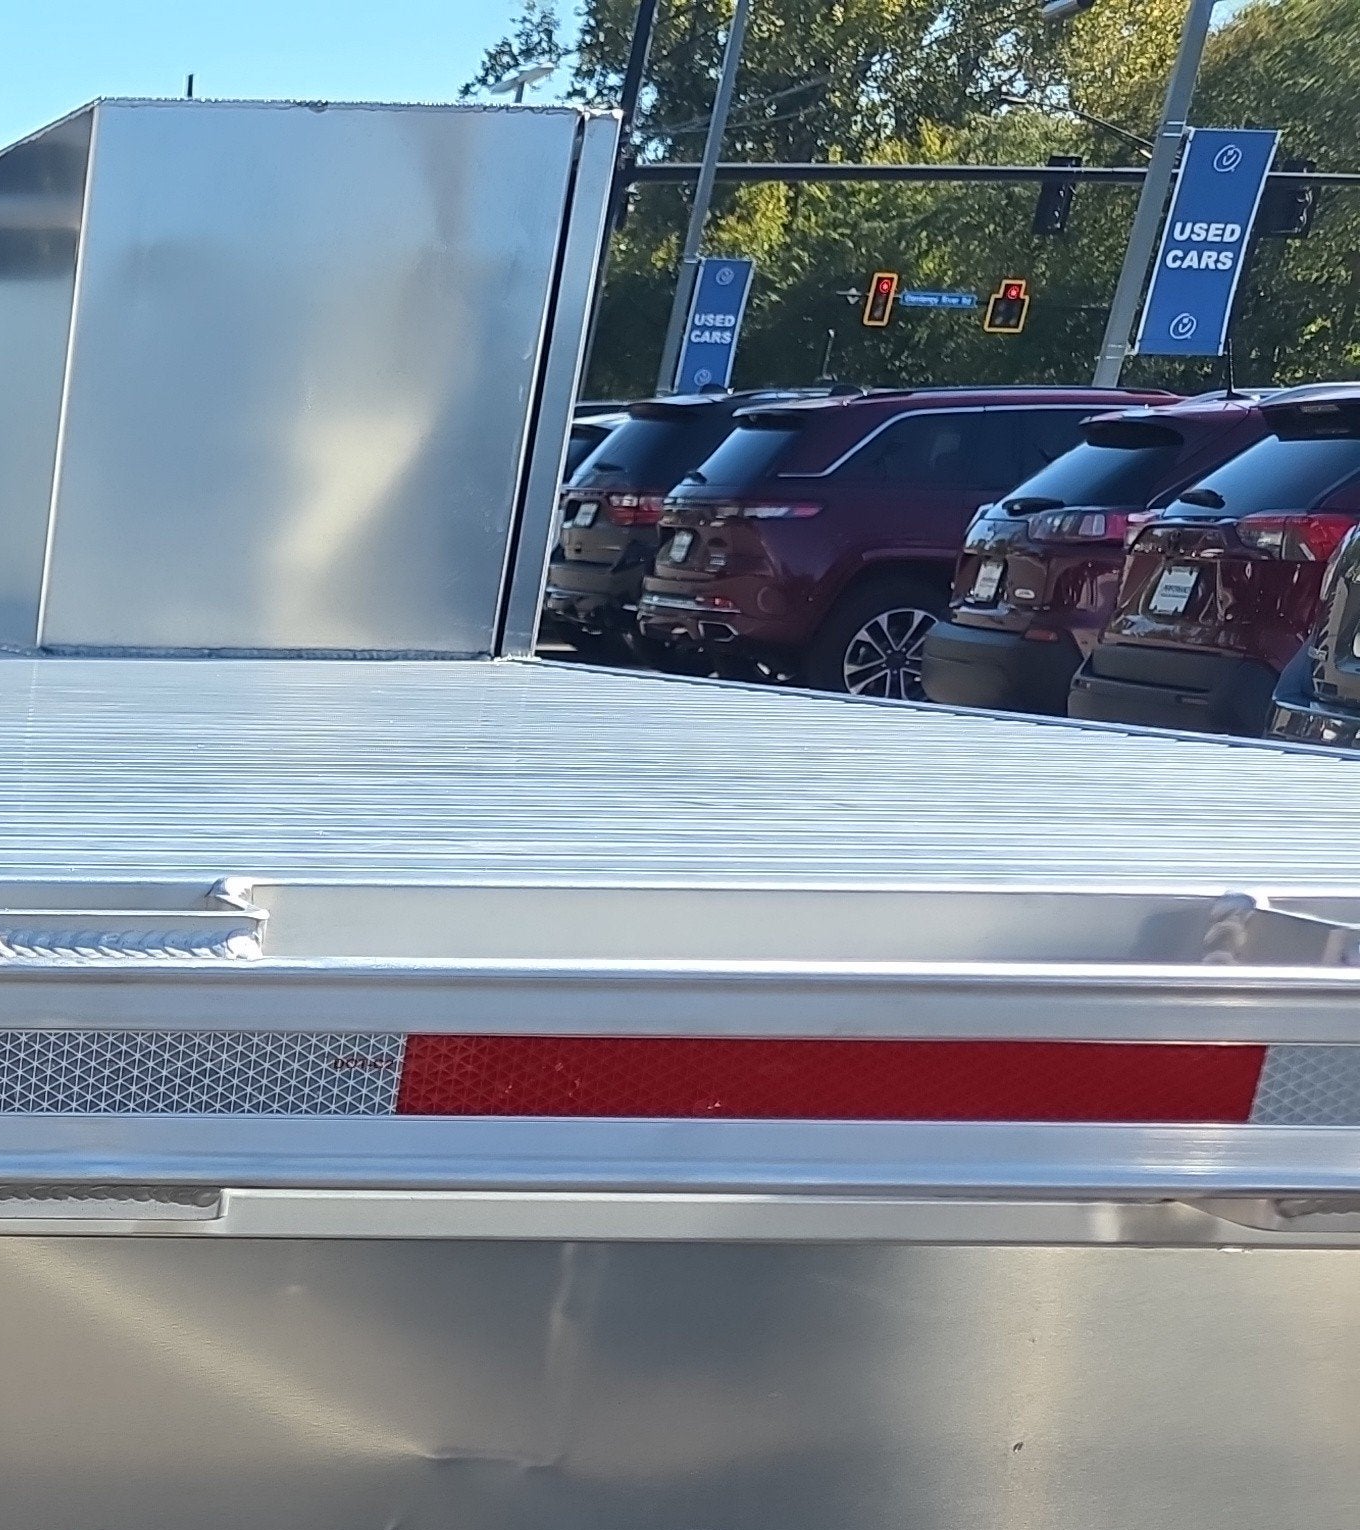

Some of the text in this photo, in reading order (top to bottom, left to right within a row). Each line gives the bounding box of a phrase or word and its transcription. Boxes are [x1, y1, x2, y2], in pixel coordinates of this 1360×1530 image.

[1173, 222, 1241, 243] USED
[1165, 249, 1235, 270] CARS
[694, 313, 736, 327] USED
[690, 329, 732, 344] CARS
[333, 1058, 394, 1070] DOT-C2
